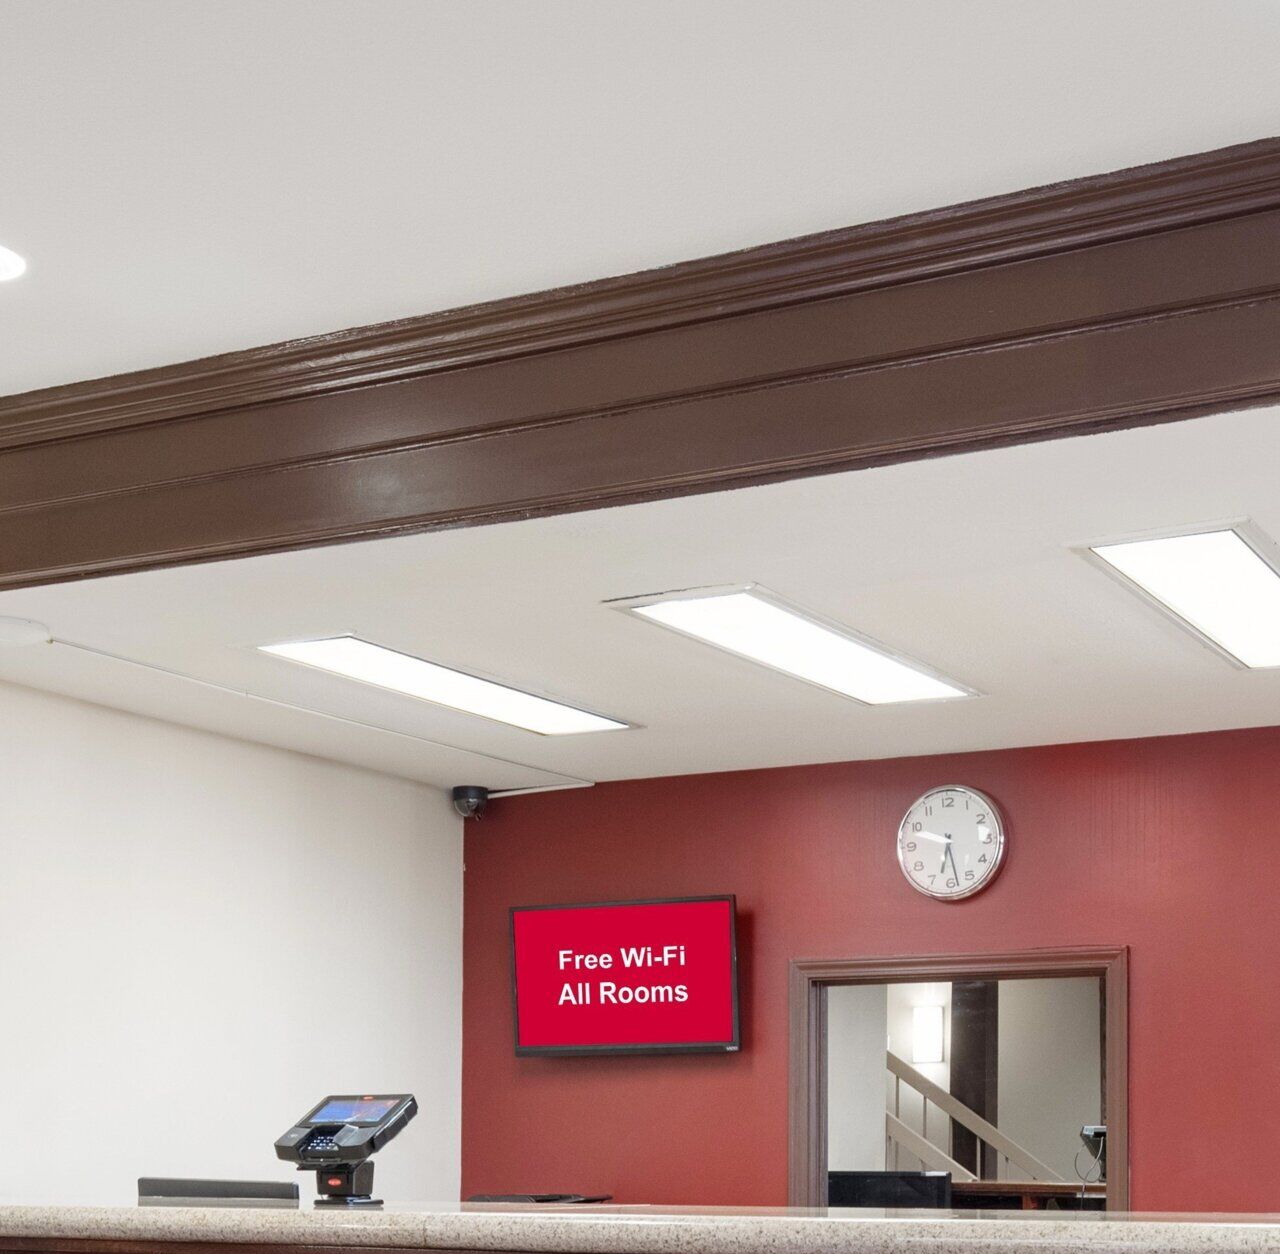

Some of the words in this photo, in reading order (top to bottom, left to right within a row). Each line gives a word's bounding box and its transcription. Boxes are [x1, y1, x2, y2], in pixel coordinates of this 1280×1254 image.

[942, 797, 955, 808] 12
[925, 806, 933, 817] 11
[976, 813, 987, 825] 2
[912, 821, 923, 832] 10
[982, 833, 993, 845] 3
[906, 841, 917, 852] 9
[977, 853, 988, 864] 4
[913, 861, 925, 871] 8
[928, 874, 937, 885] 7
[964, 870, 975, 881] 5
[946, 878, 956, 889] 6
[558, 949, 613, 970] Free
[620, 945, 685, 968] Wi-Fi
[558, 982, 590, 1005] All
[599, 981, 688, 1004] Rooms
